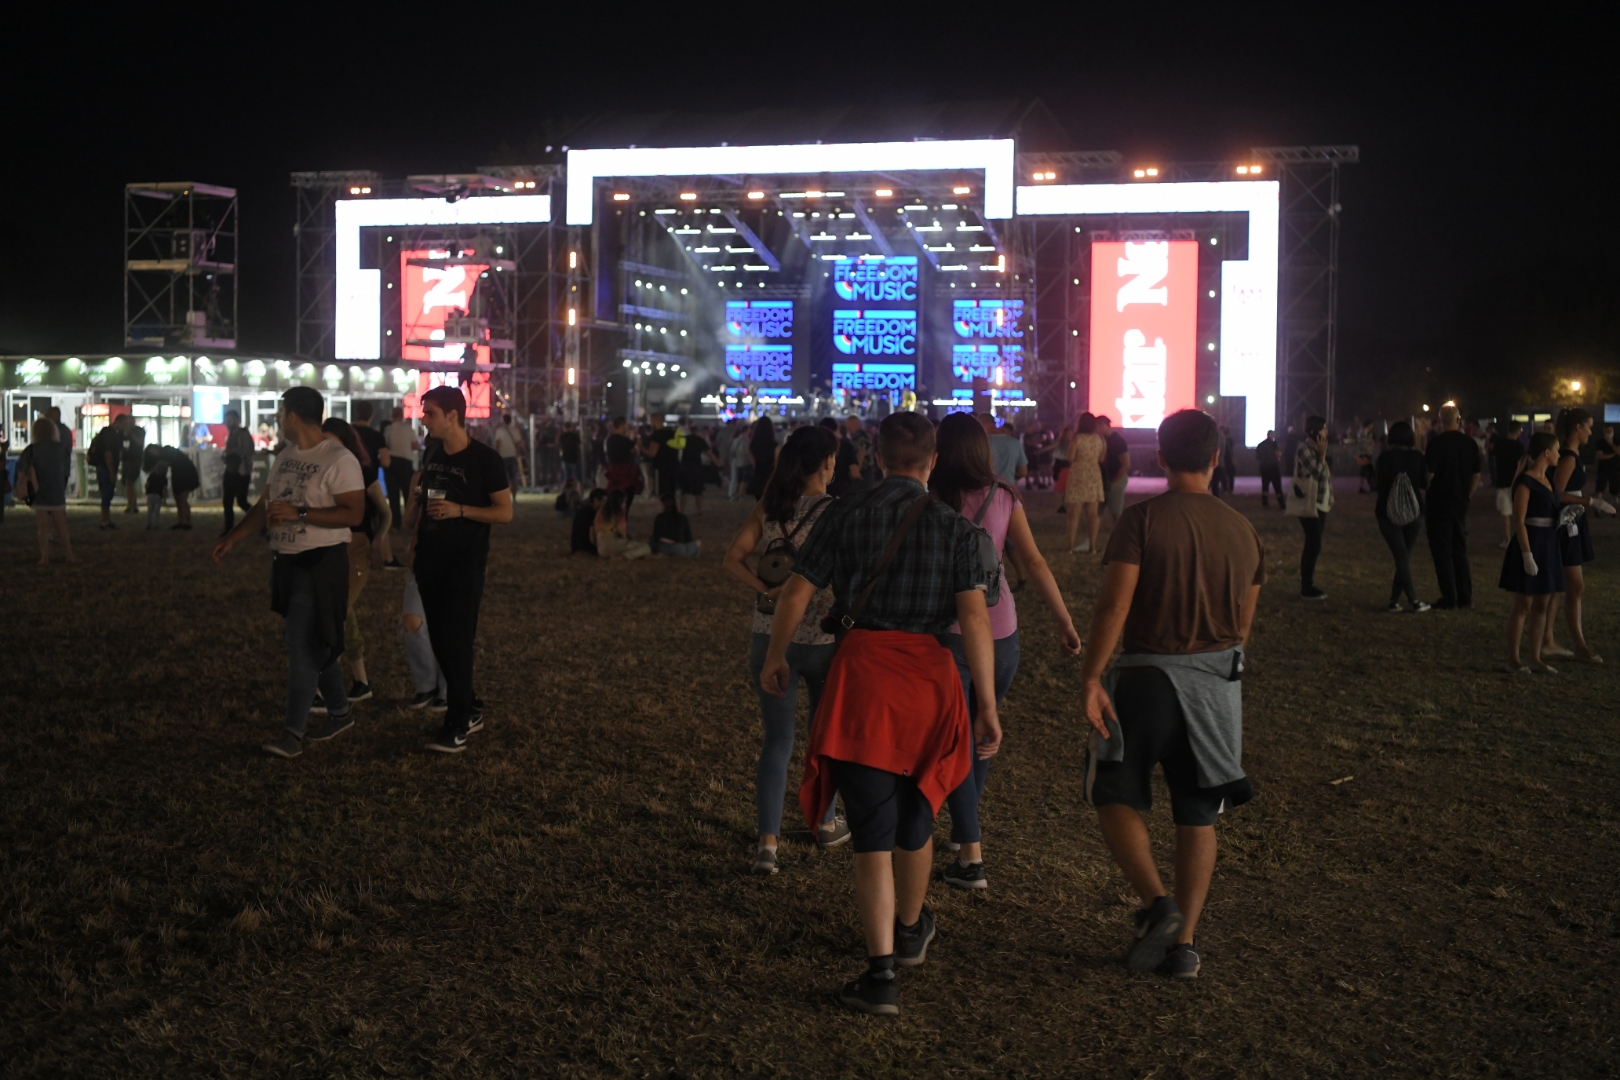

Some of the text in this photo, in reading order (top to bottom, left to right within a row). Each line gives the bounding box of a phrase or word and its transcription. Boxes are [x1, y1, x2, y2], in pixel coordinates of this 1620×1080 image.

[726, 308, 793, 322] FREEDOM
[833, 319, 917, 336] FREEDOM
[725, 351, 793, 366] FREEDOM
[832, 372, 915, 389] FREEDOM
